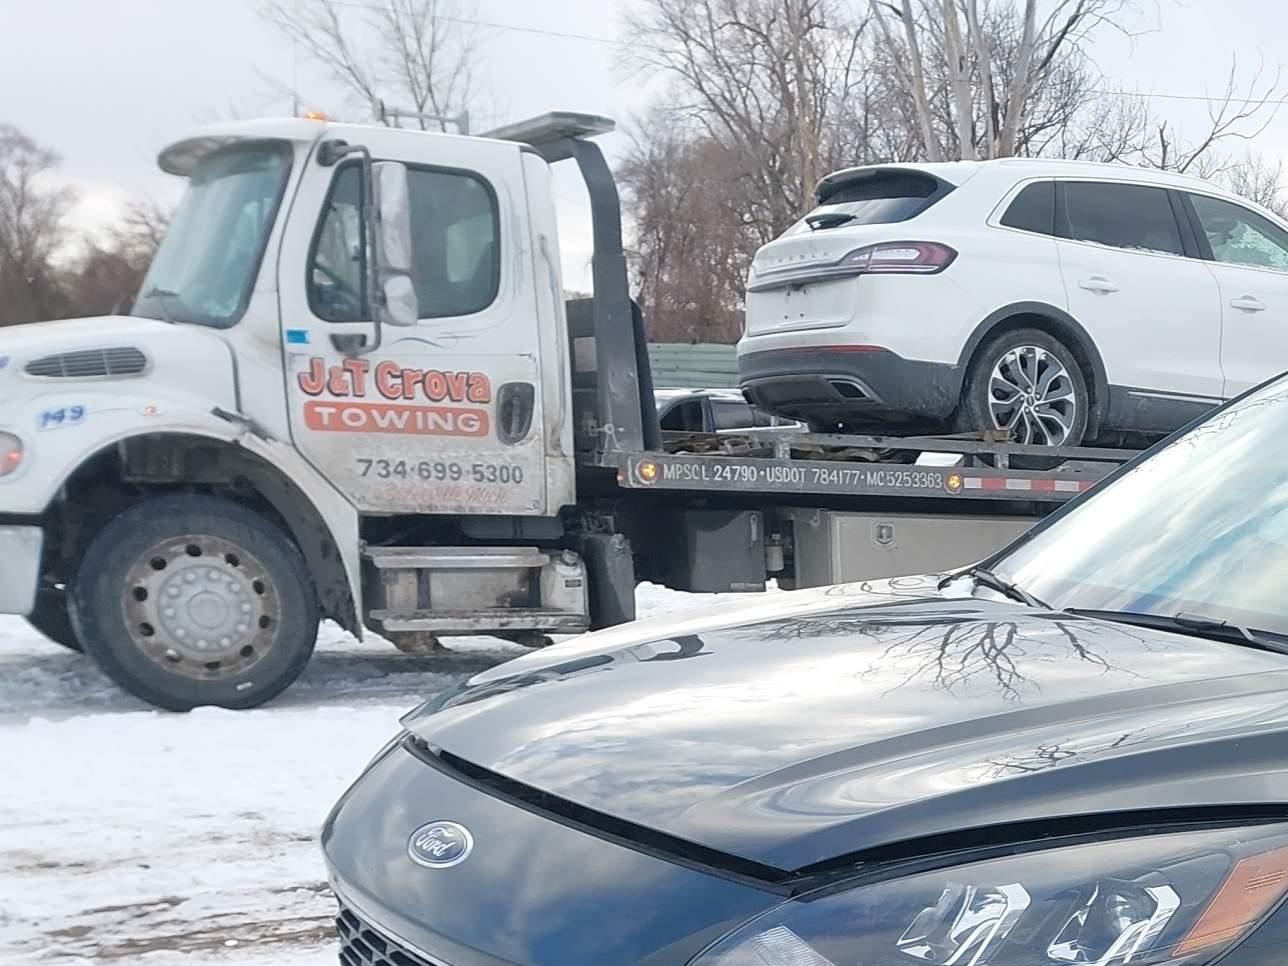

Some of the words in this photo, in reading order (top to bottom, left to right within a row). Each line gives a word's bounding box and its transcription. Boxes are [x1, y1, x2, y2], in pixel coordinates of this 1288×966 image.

[298, 357, 369, 396] J&T
[375, 360, 491, 403] Crova
[313, 406, 481, 433] TOWING
